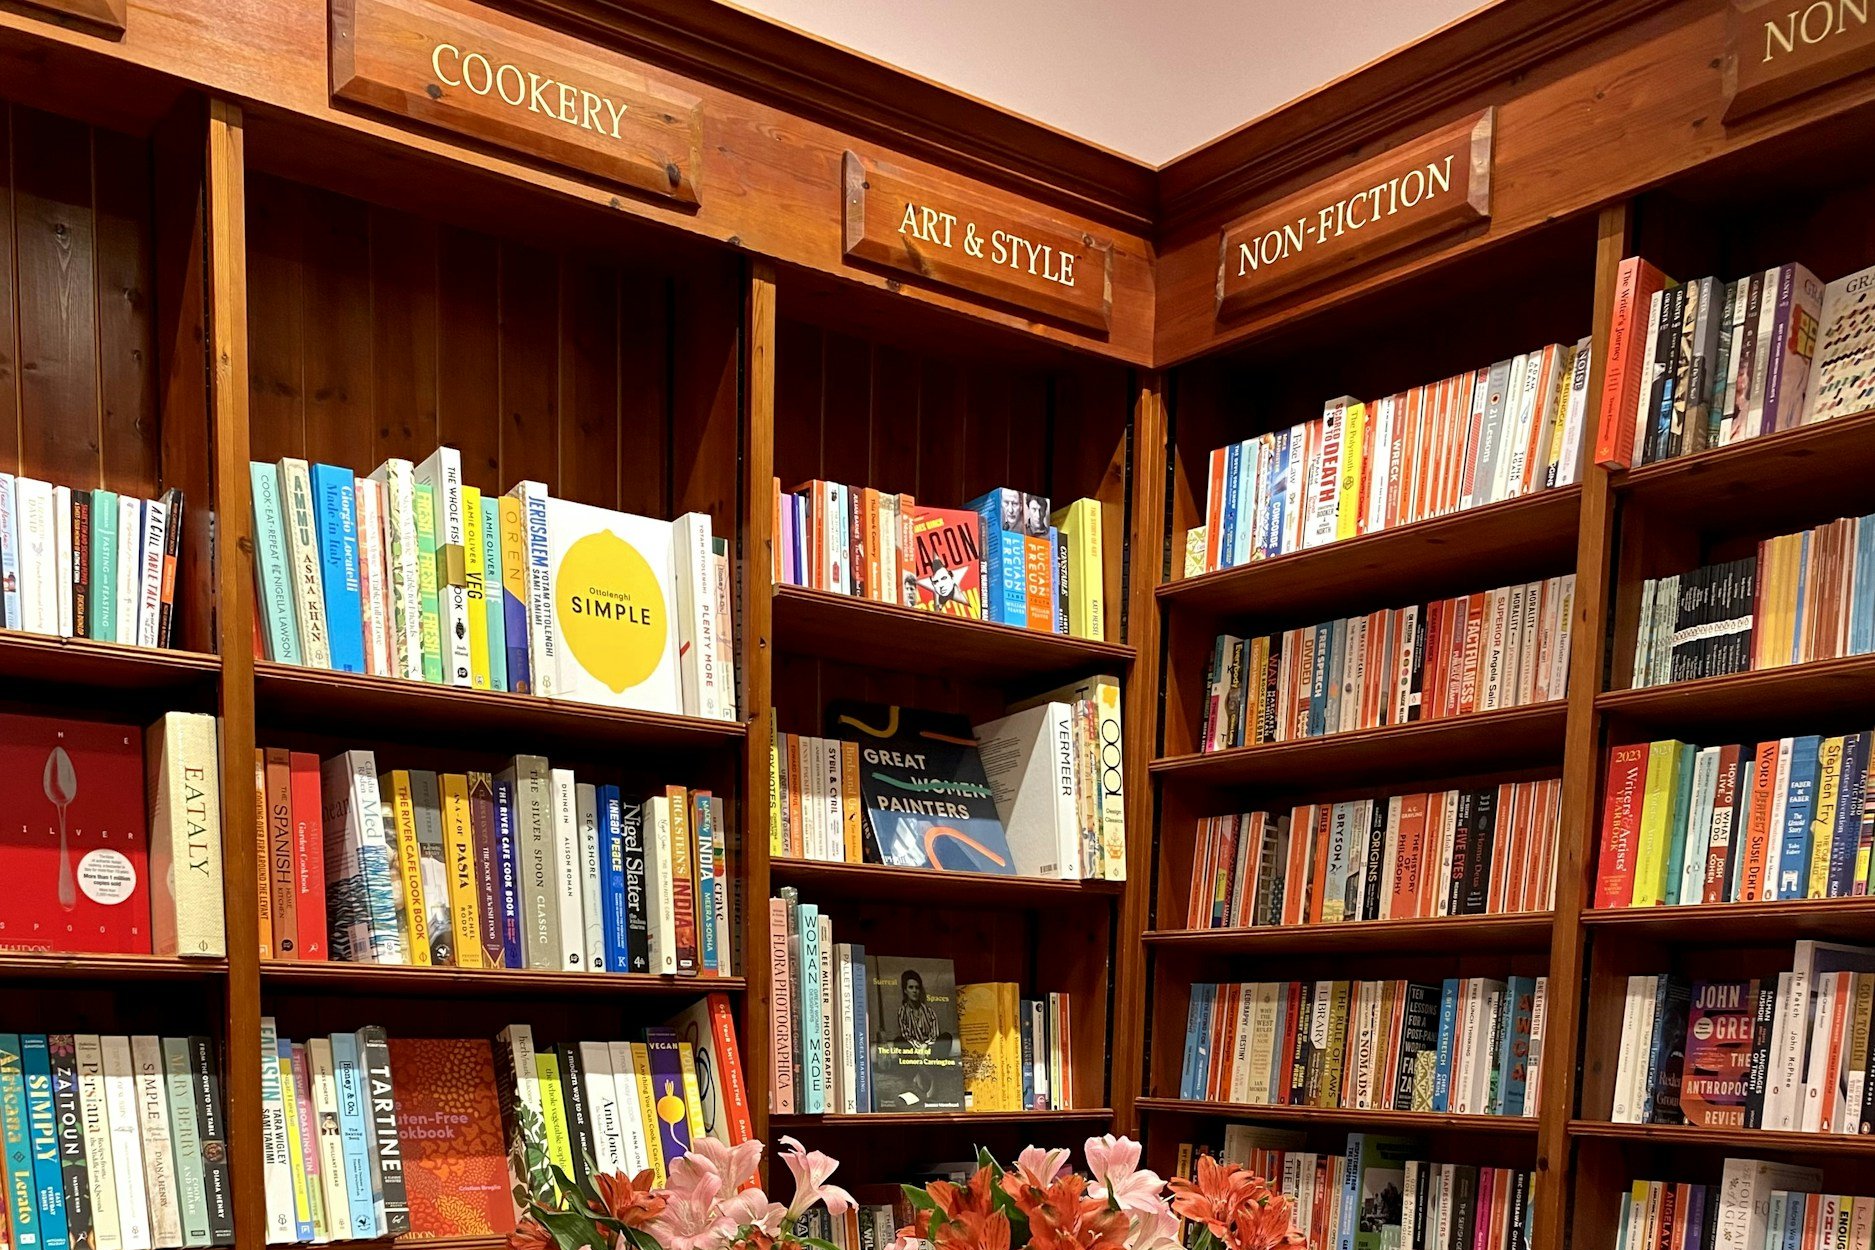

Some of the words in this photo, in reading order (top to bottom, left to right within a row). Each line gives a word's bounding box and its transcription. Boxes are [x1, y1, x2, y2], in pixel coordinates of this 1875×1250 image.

[431, 43, 629, 139] COOKERY
[1236, 155, 1456, 277] NON-FICTION
[897, 202, 957, 249] ART
[964, 225, 985, 258] &
[990, 230, 1076, 287] STYLE
[1623, 269, 1632, 281] The
[1617, 283, 1631, 324] Writer's
[1611, 327, 1622, 361] Journey
[1318, 439, 1340, 503] DEATH
[294, 476, 309, 546] AMMU
[341, 486, 353, 533] Giorgio
[506, 511, 520, 581] OREN
[529, 496, 549, 568] JERUSALEM
[304, 554, 316, 594] ASMA
[344, 536, 358, 591] Locatelli
[533, 569, 541, 591] SAMI
[542, 570, 550, 600] YOTAM
[1028, 543, 1038, 595] FREUD
[1036, 545, 1046, 596] LUCIAN
[466, 572, 482, 600] VEG
[589, 587, 631, 601] Ottolenghi
[308, 602, 321, 642] KHAN
[534, 593, 543, 625] TAMIMI
[544, 603, 553, 657] OTTOLENGHI
[571, 596, 651, 625] SIMPLE
[702, 605, 711, 650] PLENTY
[1511, 592, 1521, 632] MORALITY
[704, 653, 713, 687] MORE
[1461, 618, 1481, 704] FACTFULNESS
[863, 749, 925, 770] GREAT
[1059, 719, 1072, 796] VERMEER
[1823, 745, 1841, 798] Stephen
[398, 786, 408, 806] THE
[530, 770, 538, 793] THE
[184, 766, 209, 878] EATALY
[401, 807, 413, 842] RIVER
[531, 800, 541, 841] SILVER
[621, 802, 642, 852] Nigel
[877, 796, 970, 820] PAINTERS
[1816, 804, 1834, 824] Fry
[274, 805, 290, 883] SPANISH
[405, 845, 417, 874] CAFE
[698, 836, 713, 881] INDIA
[1333, 813, 1345, 862] BRYSON
[1368, 830, 1382, 882] ORIGINS
[409, 874, 421, 905] LOOK
[534, 849, 544, 888] SPOON
[626, 857, 644, 912] Slater
[414, 907, 425, 939] BOOK
[536, 895, 548, 944] CLASSIC
[704, 892, 712, 919] MEERA
[705, 920, 713, 952] SODHA
[805, 916, 818, 984] WOMAN
[1696, 985, 1740, 1008] JOHN
[650, 1042, 678, 1050] VEGAN
[810, 1039, 821, 1091] MADE
[28, 1075, 57, 1162] SIMPLY
[57, 1067, 79, 1155] ZAITOUN
[370, 1066, 401, 1172] TARTINE
[1822, 1202, 1834, 1245] SHE
